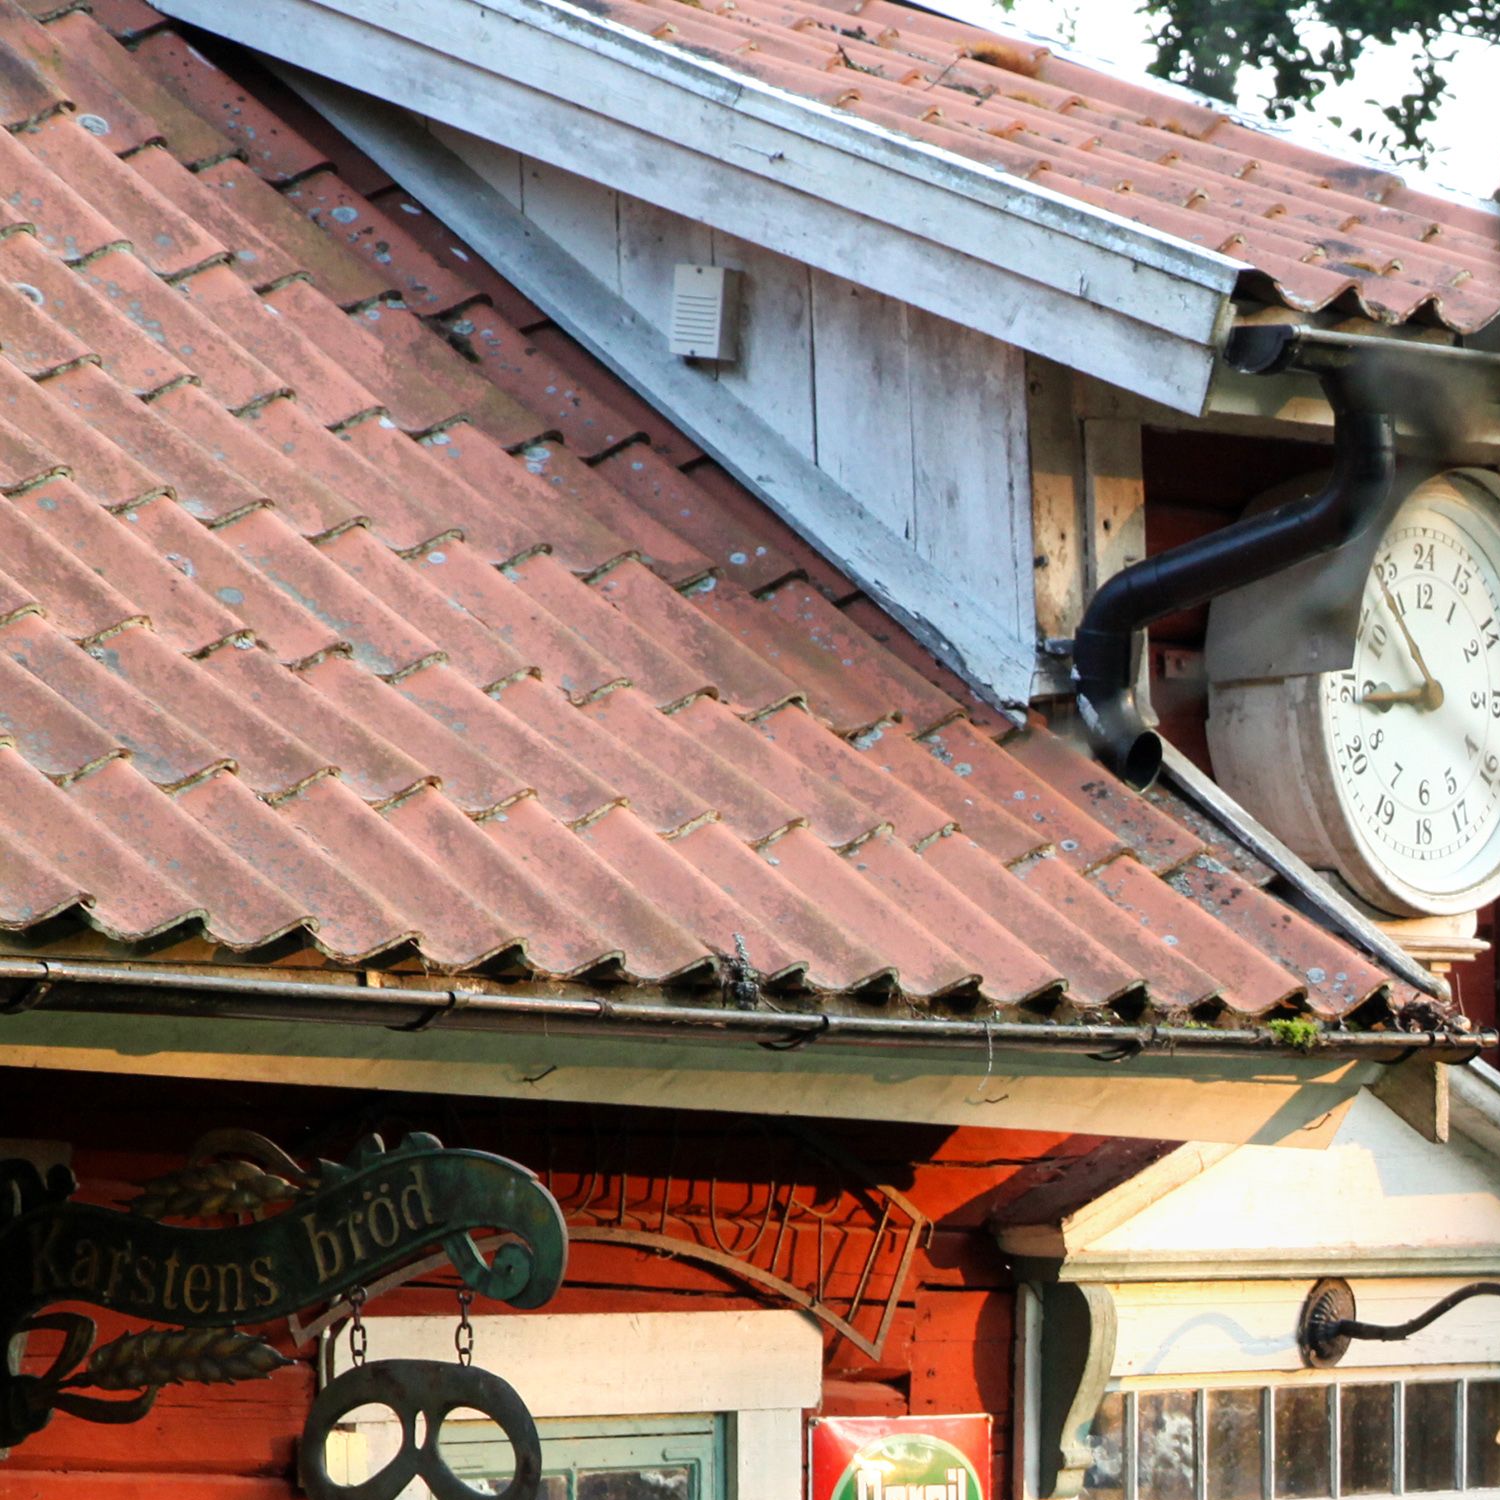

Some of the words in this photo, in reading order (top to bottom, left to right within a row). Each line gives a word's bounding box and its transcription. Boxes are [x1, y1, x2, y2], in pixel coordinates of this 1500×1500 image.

[1413, 543, 1435, 571] 24
[1452, 564, 1472, 595] 13
[1416, 583, 1433, 610] 12
[1446, 602, 1456, 625] 1
[1368, 624, 1387, 661] 10
[1480, 617, 1500, 650] 14
[1463, 639, 1479, 663] 2
[1340, 673, 1356, 703] 21
[1470, 692, 1486, 709] 3
[1369, 729, 1384, 750] 8
[1464, 734, 1480, 760] 4
[1346, 735, 1368, 775] 20
[1391, 762, 1403, 789] 7
[1444, 767, 1457, 795] 5
[1479, 754, 1500, 787] 16
[1419, 779, 1430, 806] 6
[1374, 794, 1395, 825] 19
[1451, 799, 1470, 834] 17
[1415, 818, 1432, 845] 18
[27, 1222, 280, 1313] Karstens
[301, 1165, 435, 1283] bröd
